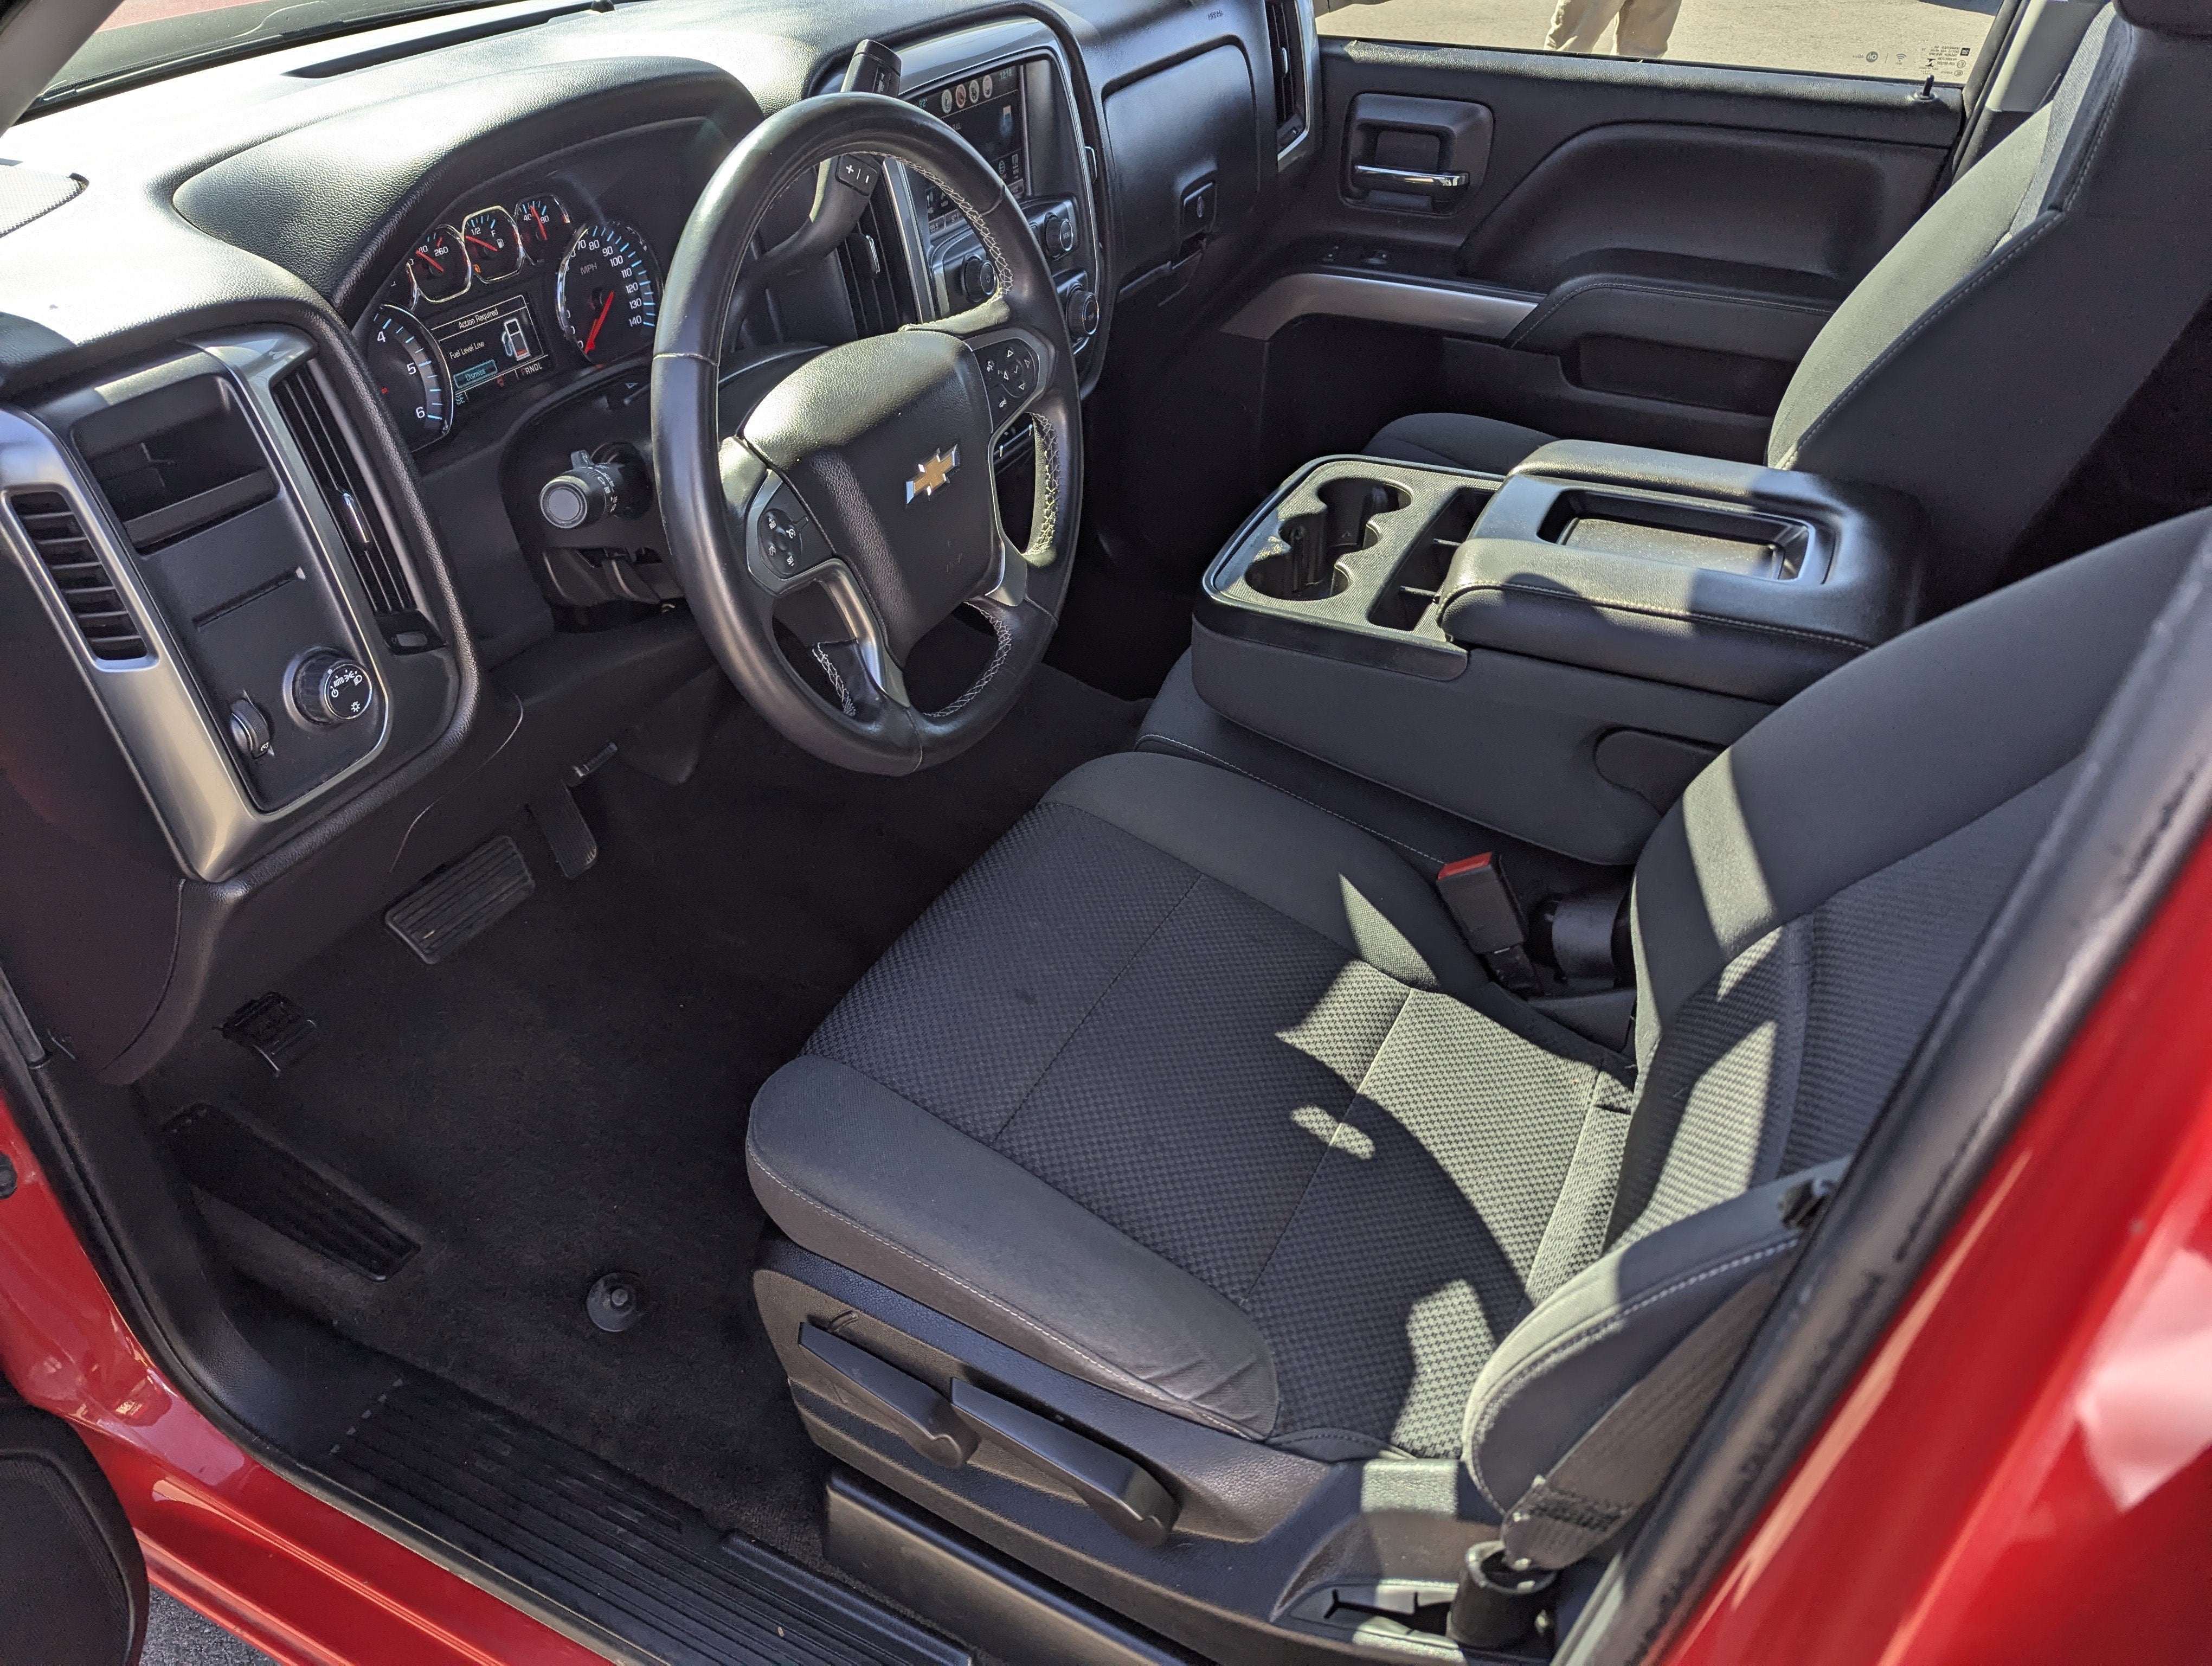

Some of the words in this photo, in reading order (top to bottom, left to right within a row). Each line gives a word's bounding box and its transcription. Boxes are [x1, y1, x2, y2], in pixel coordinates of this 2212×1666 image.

[471, 227, 481, 236] 1/2
[434, 246, 449, 257] 260
[588, 240, 600, 251] 80
[602, 246, 614, 257] 90
[609, 255, 624, 267] 100
[580, 262, 597, 275] MPH
[621, 267, 633, 279] 110
[625, 282, 639, 294] 120
[629, 298, 642, 310] 130
[459, 318, 475, 329] Action
[475, 307, 499, 323] Required
[628, 315, 642, 327] 140
[377, 331, 386, 343] 4
[449, 351, 461, 360] Fuel
[460, 344, 474, 356] Level
[473, 341, 485, 350] Low
[407, 362, 416, 375] 5
[465, 369, 486, 381] Dismiss
[415, 407, 425, 419] 6
[333, 677, 345, 687] AUTO
